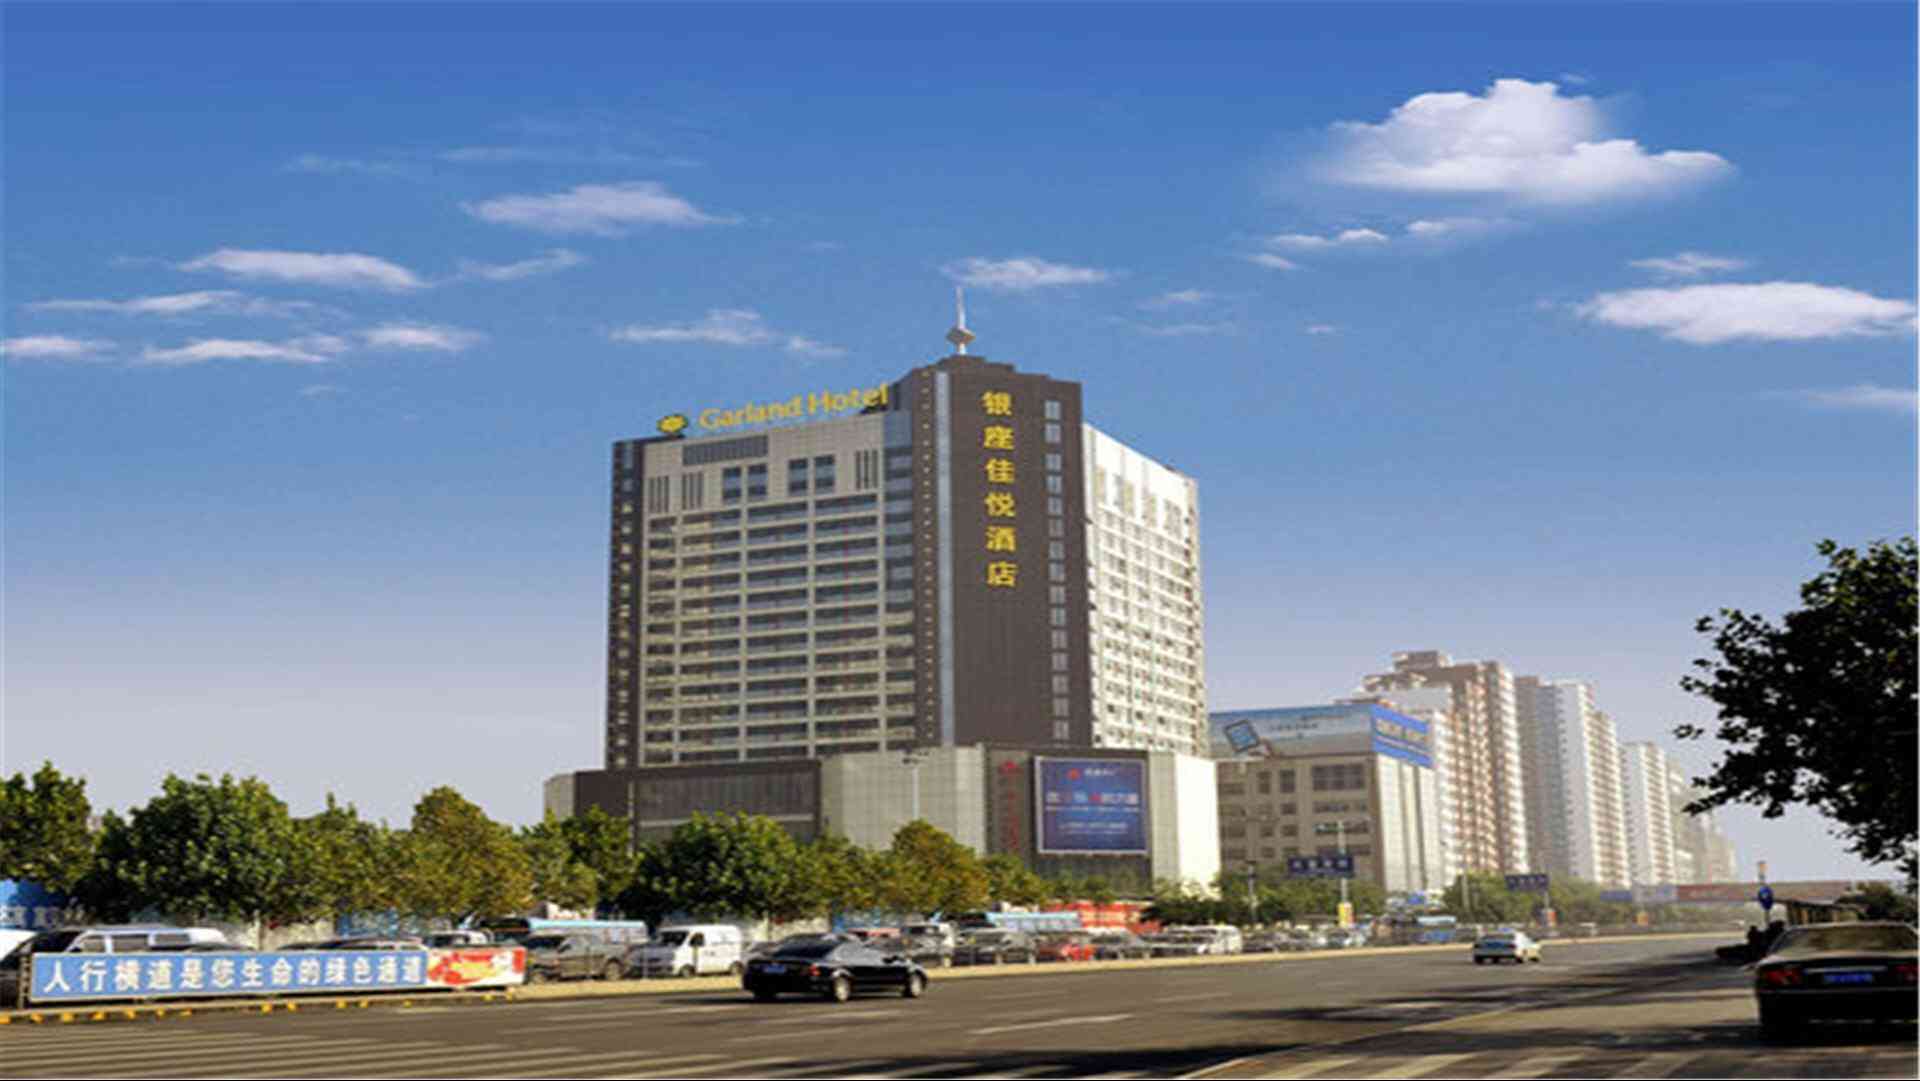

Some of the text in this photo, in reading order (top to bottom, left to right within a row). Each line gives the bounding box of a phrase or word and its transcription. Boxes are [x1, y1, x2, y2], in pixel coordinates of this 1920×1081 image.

[700, 383, 889, 430] Garland Hotel
[981, 389, 1018, 588] 银座佳悦酒店
[43, 956, 422, 993] 人行横道是您生命的绿色通道
